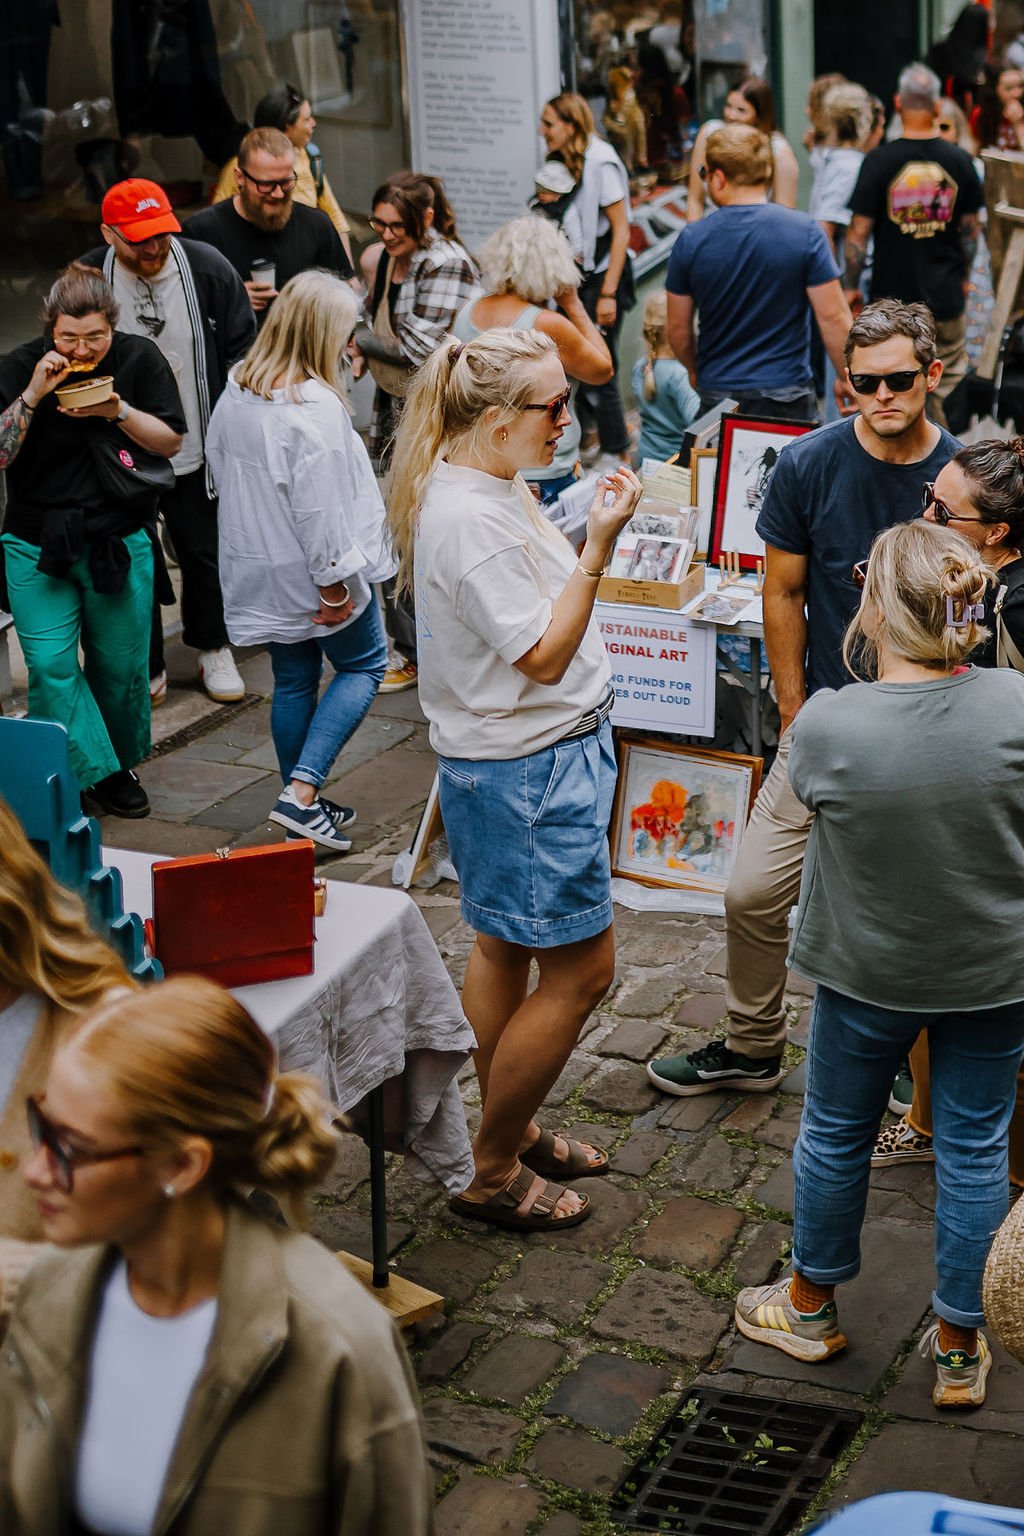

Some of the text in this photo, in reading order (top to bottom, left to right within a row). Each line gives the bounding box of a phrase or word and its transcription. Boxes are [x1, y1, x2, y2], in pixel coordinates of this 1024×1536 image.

[659, 648, 689, 663] ART
[627, 674, 666, 689] FUNDS
[669, 679, 692, 692] FOR
[632, 690, 657, 702] OUT
[660, 693, 691, 706] LOUD
